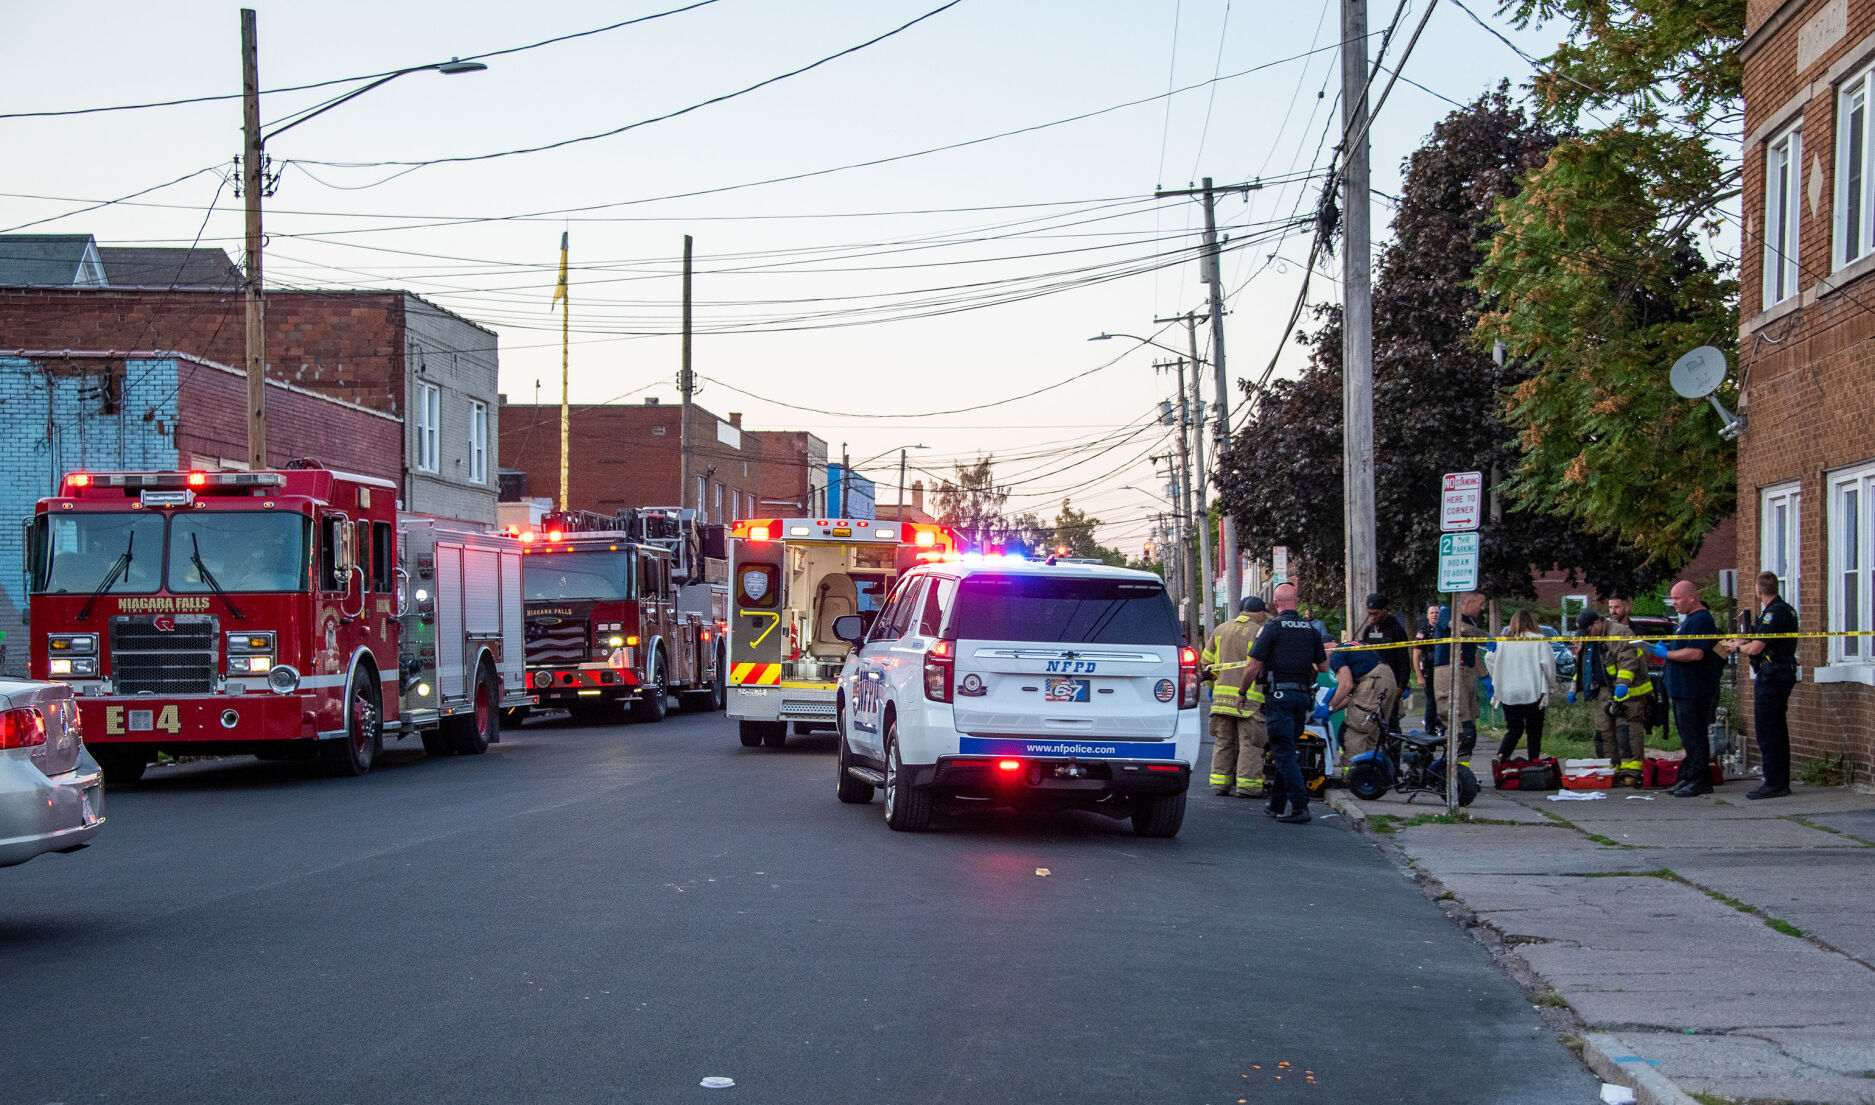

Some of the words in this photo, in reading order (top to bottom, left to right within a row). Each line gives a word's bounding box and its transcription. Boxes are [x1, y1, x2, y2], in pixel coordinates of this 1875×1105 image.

[1444, 478, 1455, 489] NO
[1455, 478, 1479, 487] STANDING
[1446, 506, 1474, 515] CORNER
[1442, 539, 1452, 553] 2
[1453, 544, 1476, 552] PARKING
[118, 597, 174, 609] NIAGARA
[175, 597, 210, 609] FALLS
[526, 608, 552, 617] NIAGARA
[554, 608, 573, 616] FALLS
[1281, 620, 1311, 629] POLICE
[1045, 660, 1097, 674] NFPD
[1052, 684, 1084, 697] 67
[106, 705, 126, 735] E
[156, 704, 182, 735] 4
[1026, 743, 1115, 755] www.nfpolice.com
